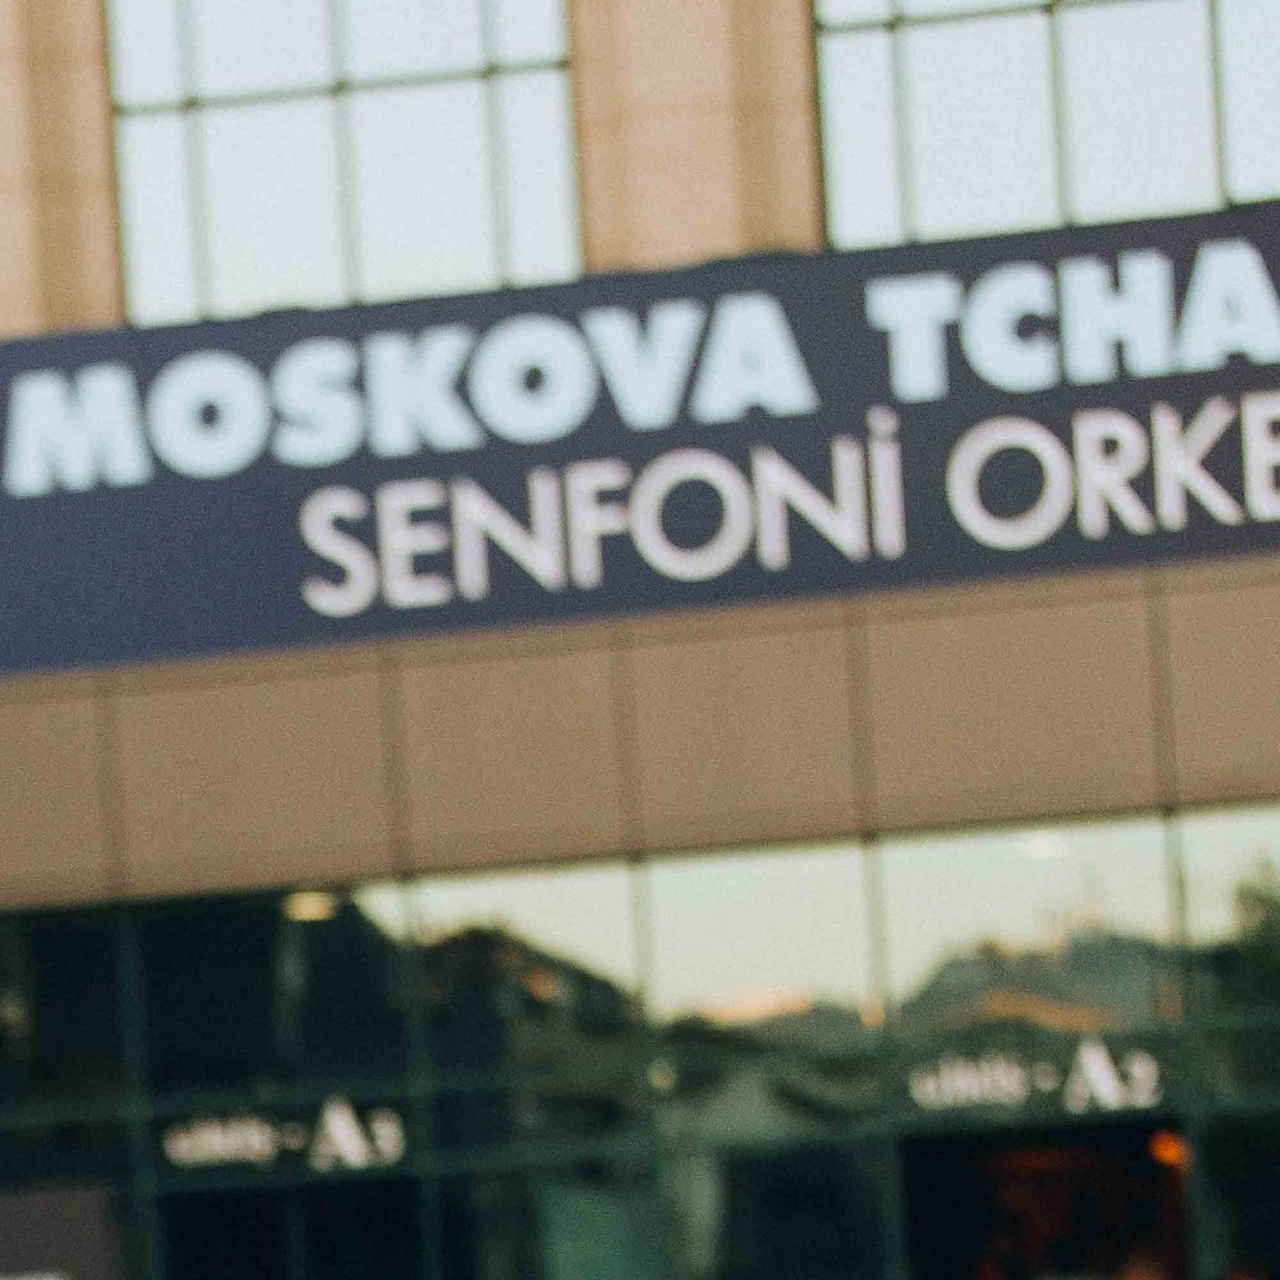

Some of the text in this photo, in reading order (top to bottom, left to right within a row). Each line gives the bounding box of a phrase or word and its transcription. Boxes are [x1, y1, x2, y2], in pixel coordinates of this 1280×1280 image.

[3, 236, 1280, 499] MOSKOVA TCHA
[299, 403, 908, 618] SENFONİ
